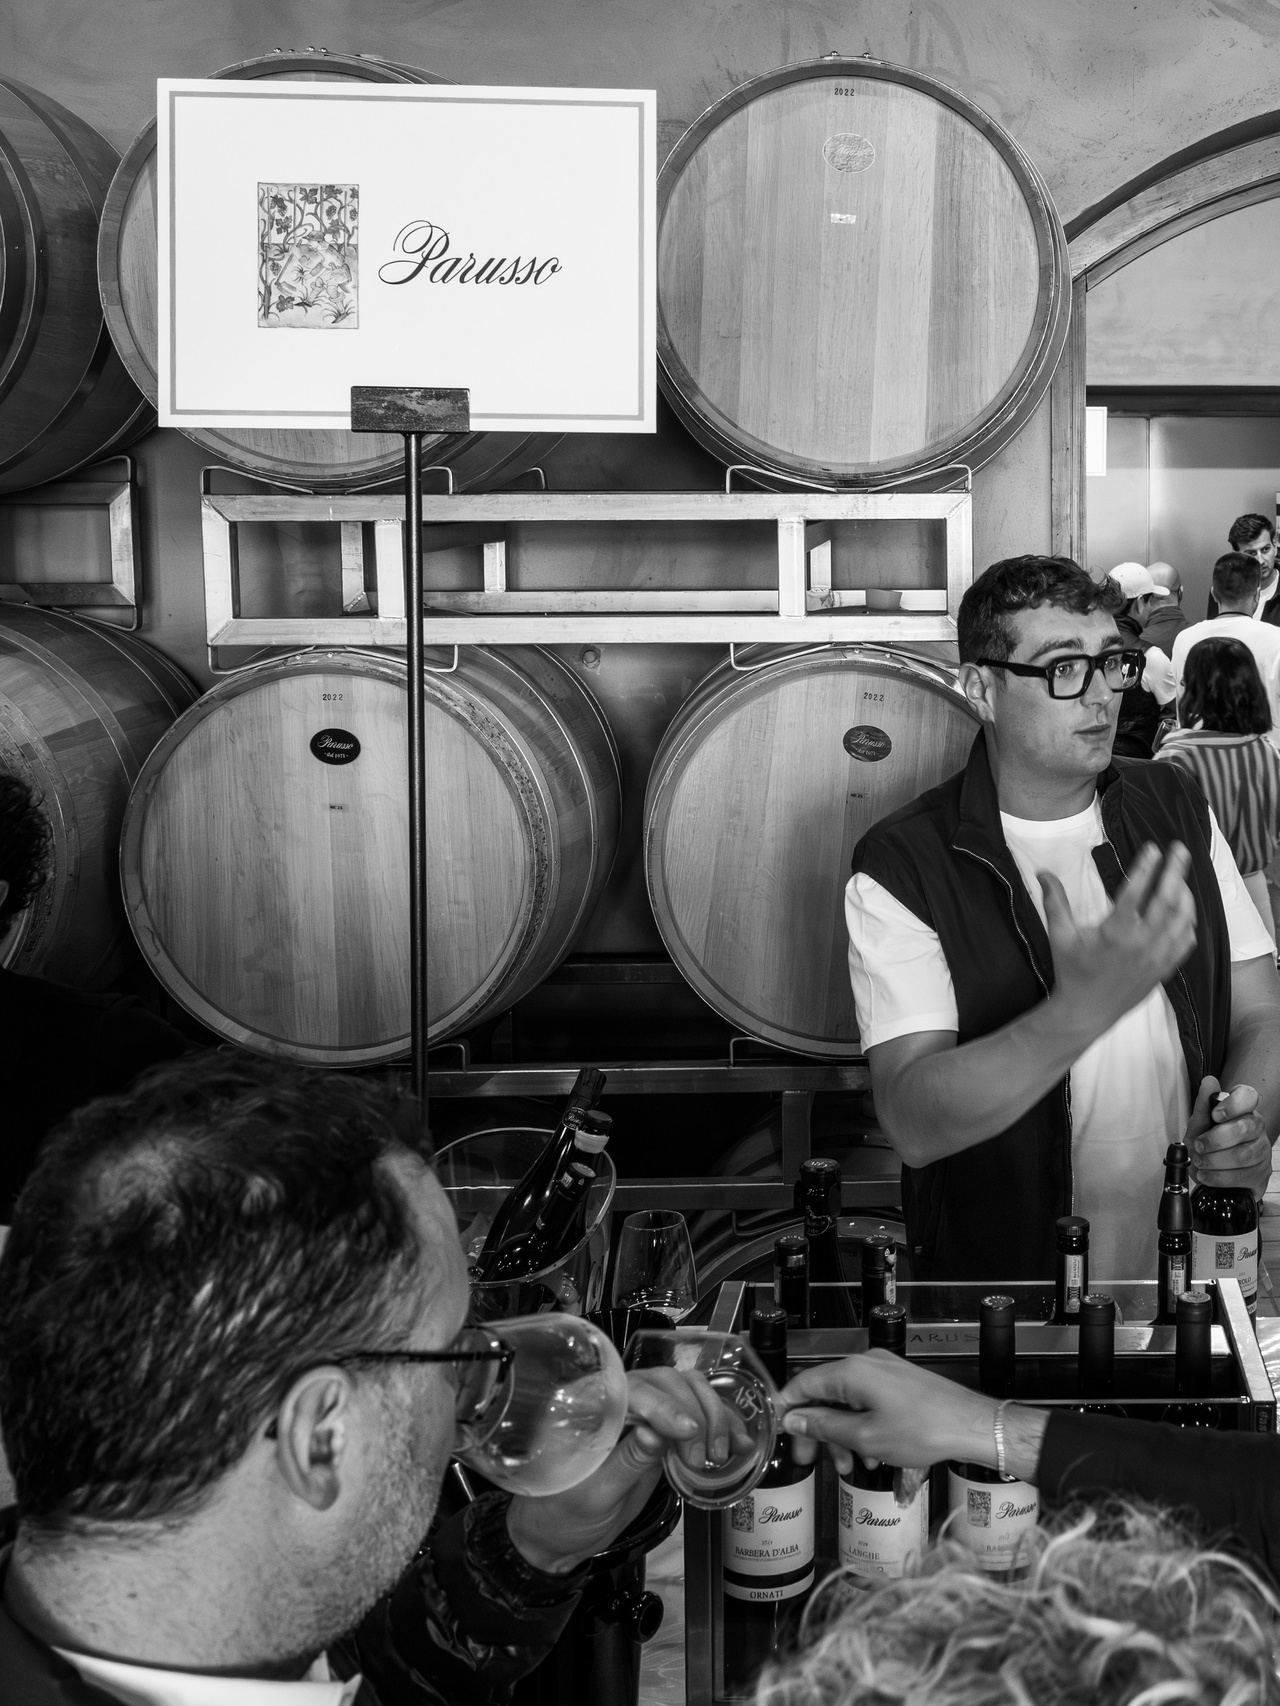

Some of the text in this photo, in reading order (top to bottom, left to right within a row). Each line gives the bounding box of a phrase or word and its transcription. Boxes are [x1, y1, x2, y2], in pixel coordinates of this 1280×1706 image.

[834, 87, 855, 96] 2022
[378, 219, 563, 286] Parusso
[322, 693, 344, 701] 2022
[863, 692, 885, 702] 2022
[317, 734, 354, 750] Parusso
[910, 1333, 980, 1343] ARUS
[758, 1505, 803, 1525] Parusso
[855, 1507, 901, 1527] Parusso
[995, 1500, 1037, 1520] Parusso
[735, 1546, 770, 1558] BARBERA
[772, 1543, 800, 1557] D'ALBA
[749, 1590, 784, 1599] ORNATI
